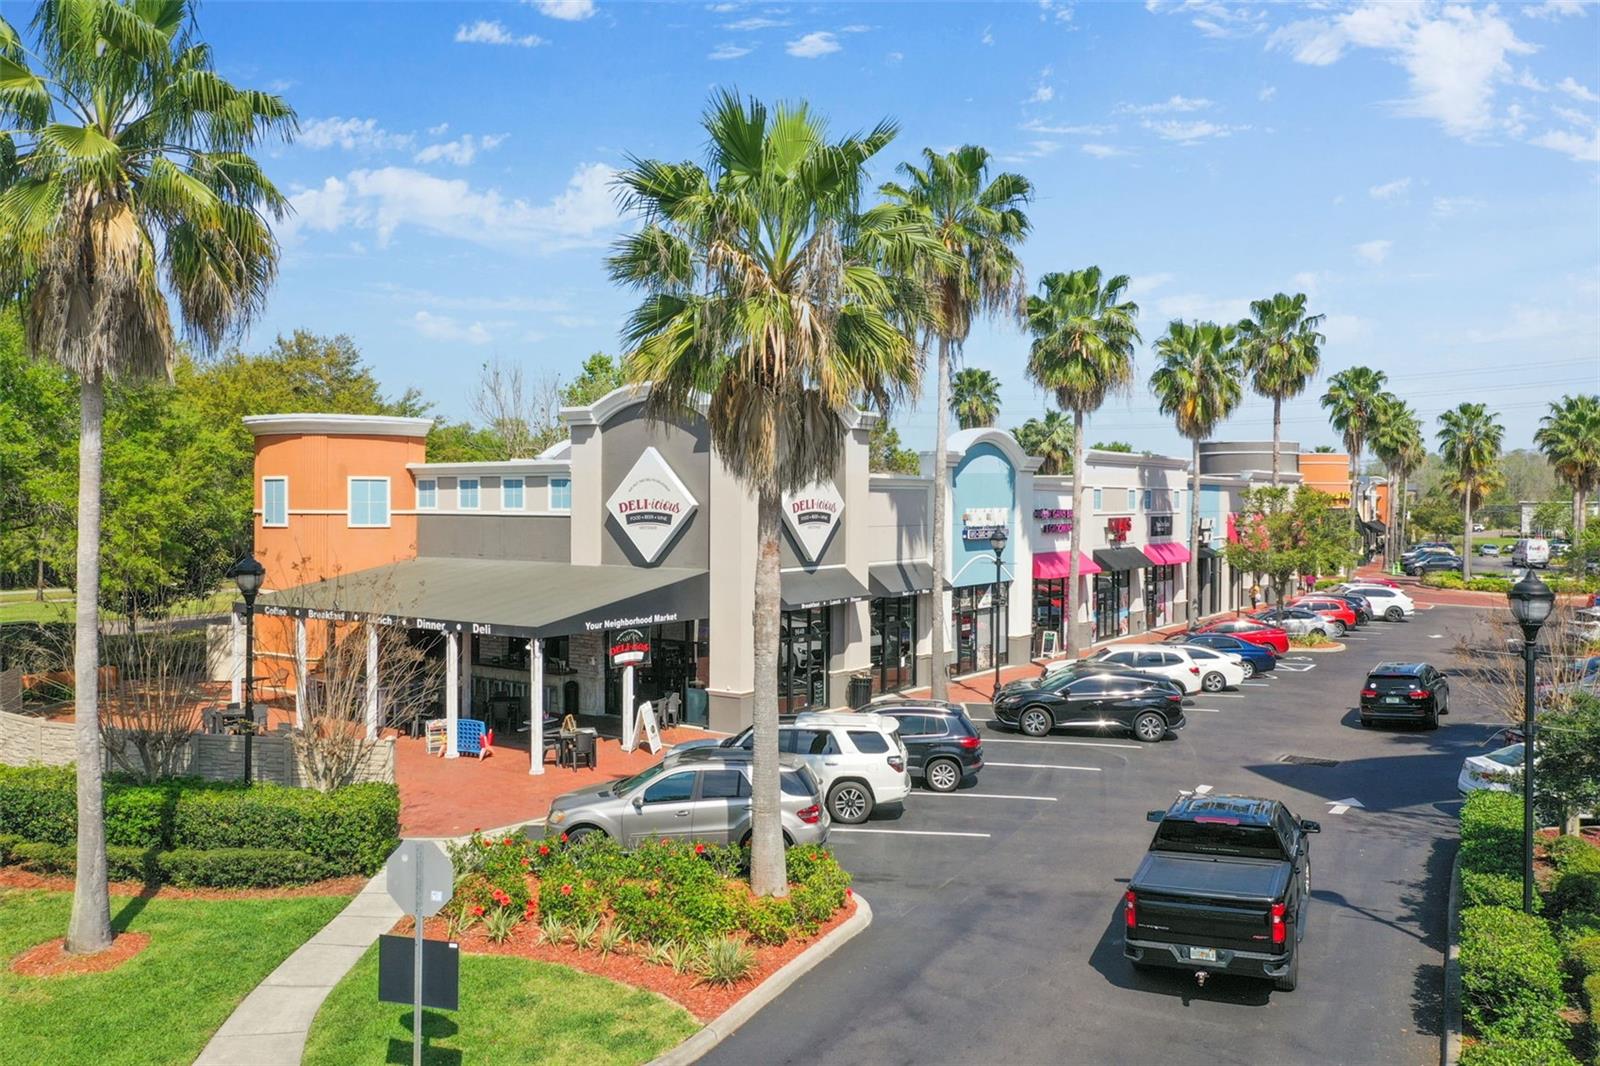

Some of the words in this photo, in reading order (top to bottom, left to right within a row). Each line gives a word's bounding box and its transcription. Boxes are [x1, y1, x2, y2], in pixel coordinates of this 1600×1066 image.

[308, 609, 345, 622] Breakfast
[416, 618, 446, 632] Dinner
[472, 622, 492, 635] Deli
[585, 621, 602, 631] Your
[604, 614, 653, 629] Neighborhood
[654, 612, 677, 622] Market
